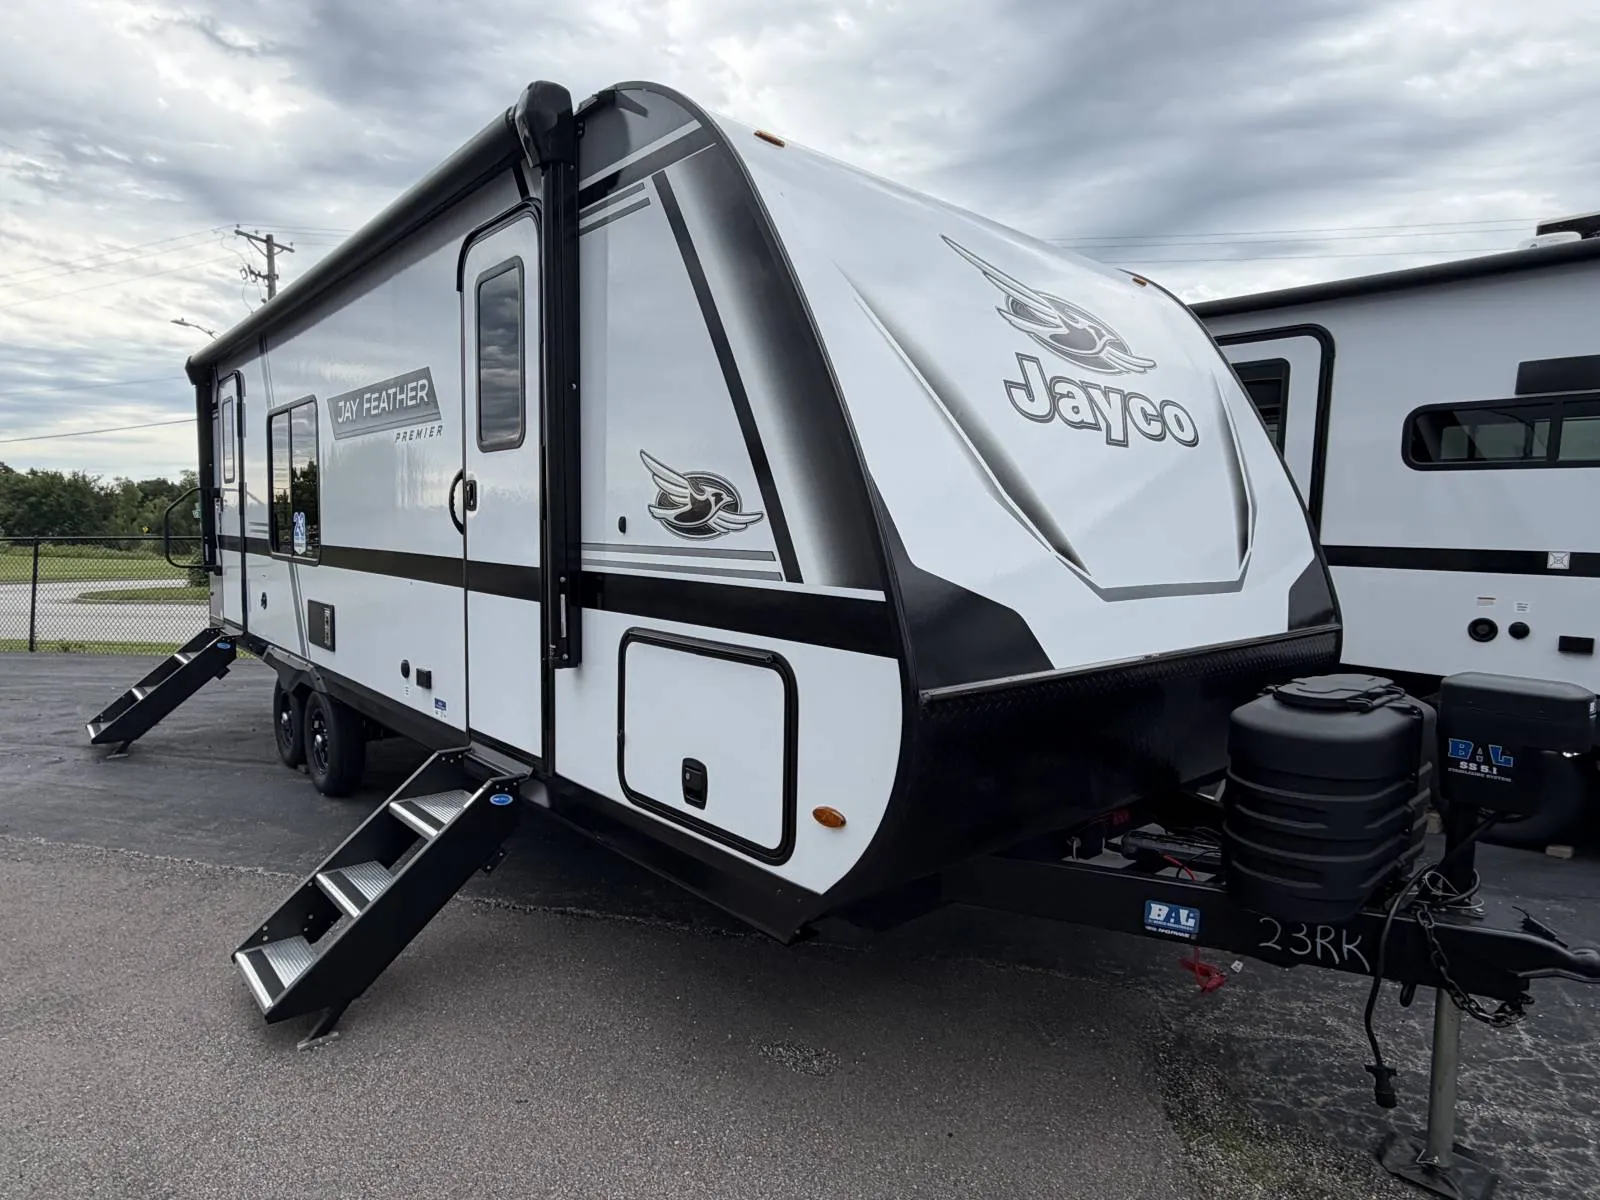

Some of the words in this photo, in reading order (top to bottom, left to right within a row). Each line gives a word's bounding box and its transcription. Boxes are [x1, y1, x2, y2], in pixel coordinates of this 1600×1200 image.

[338, 398, 359, 424] JAY
[363, 379, 429, 417] FEATHER
[1003, 352, 1199, 448] Jayco
[394, 424, 443, 443] PREMIER
[1447, 737, 1514, 768] BAL
[1149, 903, 1195, 927] BAL
[1259, 917, 1370, 973] 23RK
